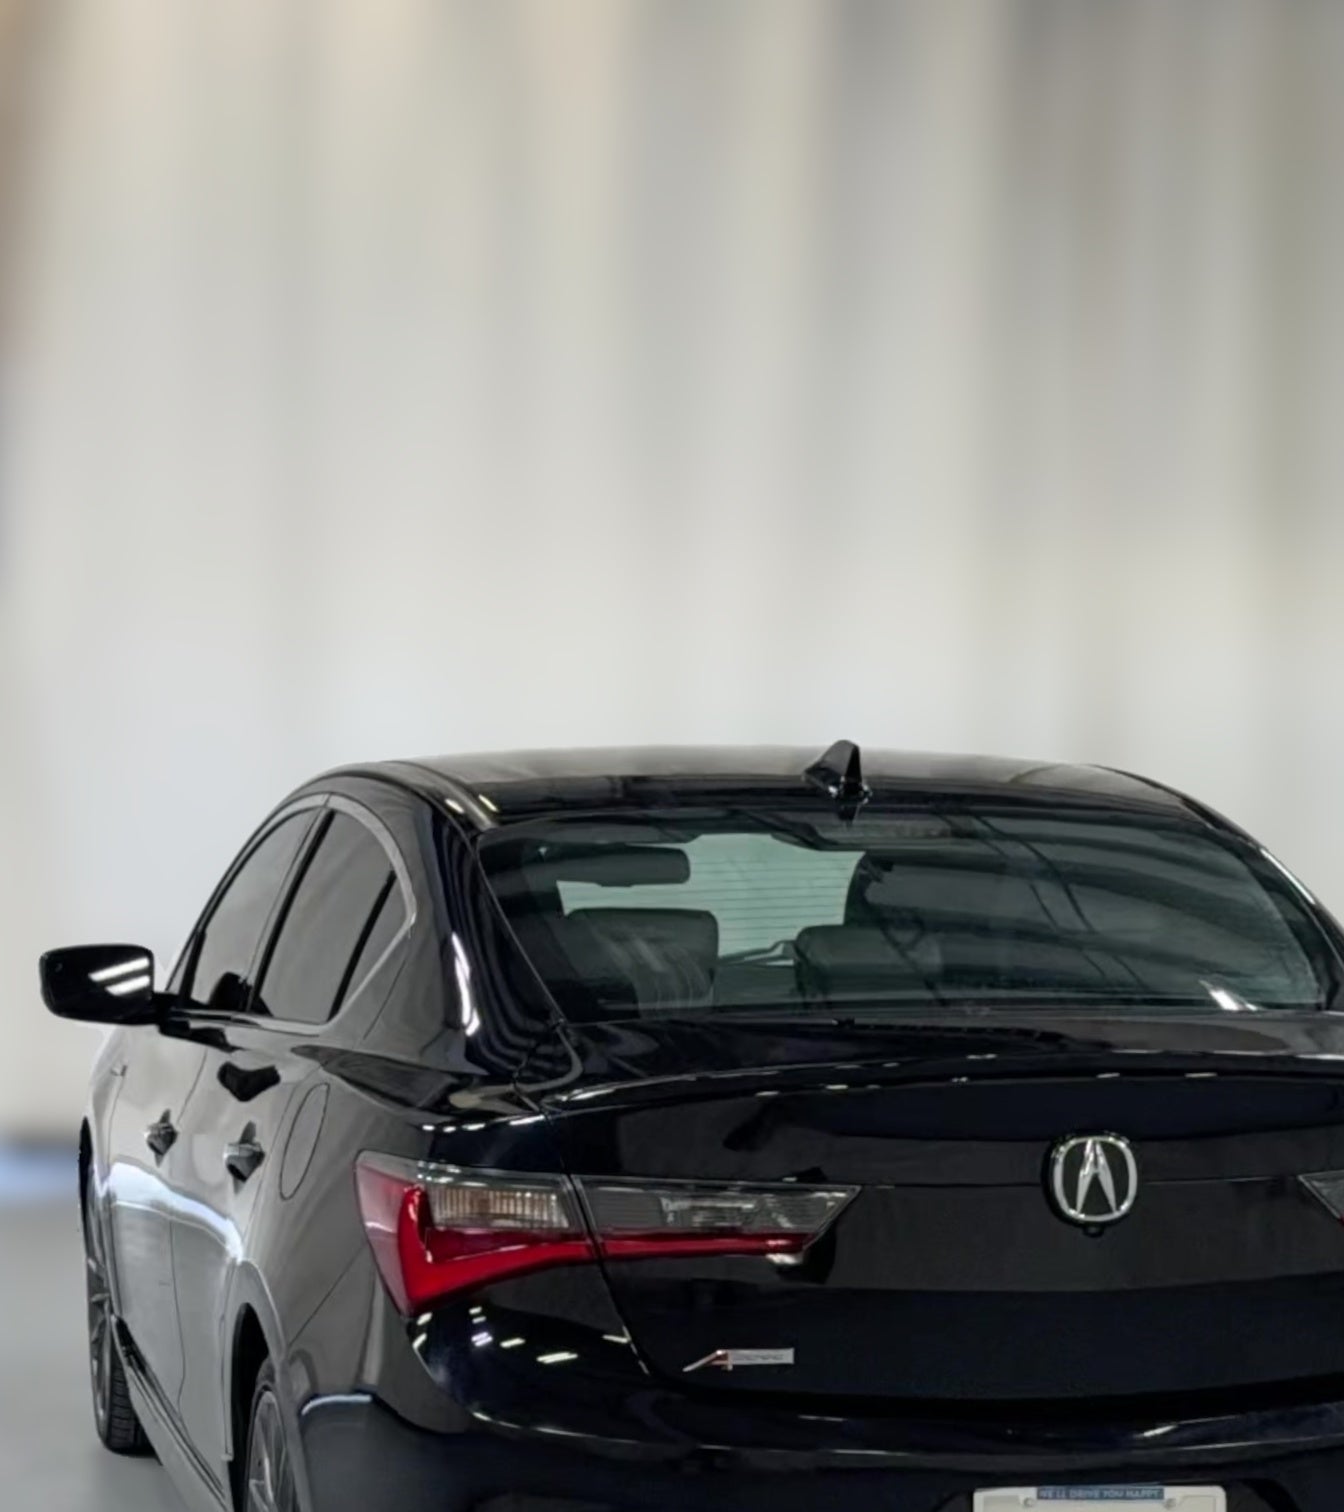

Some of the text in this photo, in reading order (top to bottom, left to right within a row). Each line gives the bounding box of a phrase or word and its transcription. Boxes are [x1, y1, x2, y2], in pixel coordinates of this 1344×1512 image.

[1069, 1488, 1100, 1499] DRIVE
[1102, 1488, 1124, 1499] YOU
[1125, 1488, 1160, 1499] HAPPY
